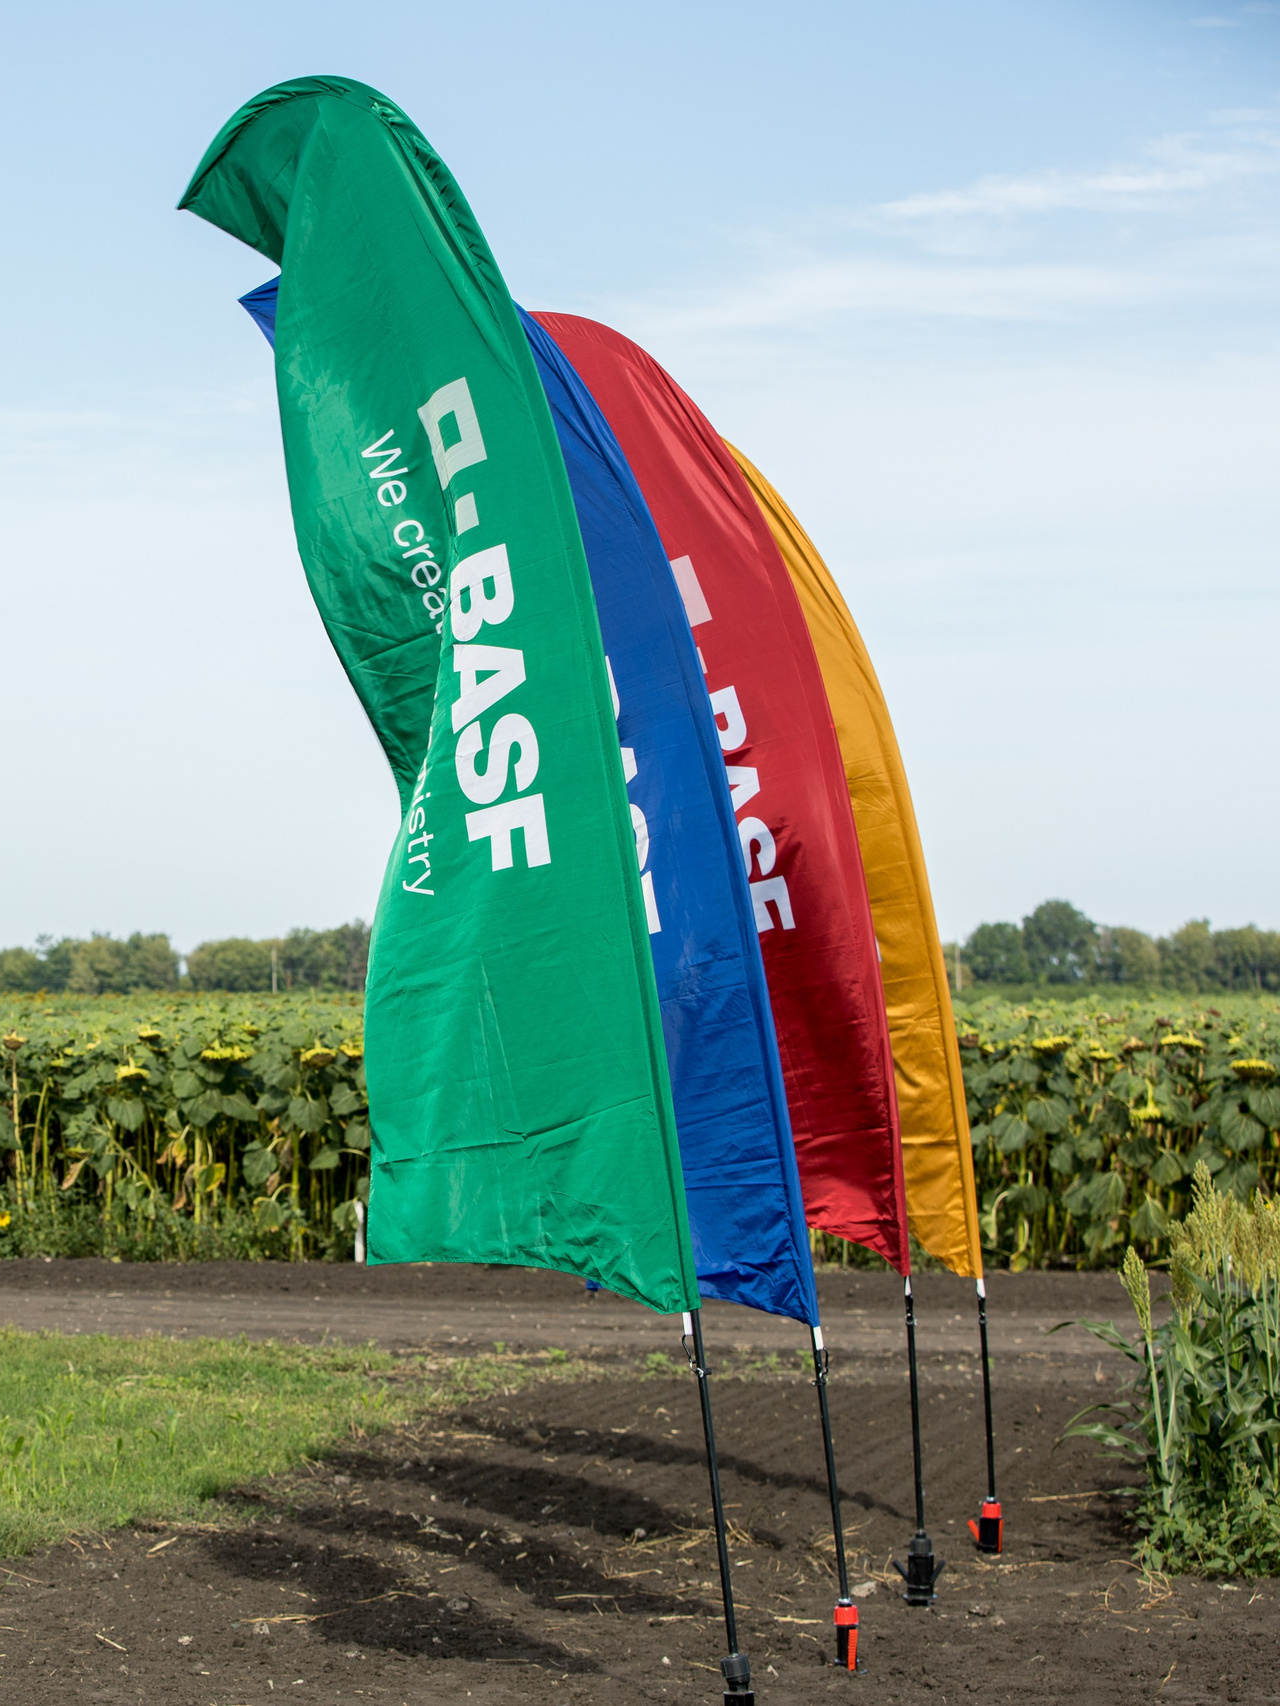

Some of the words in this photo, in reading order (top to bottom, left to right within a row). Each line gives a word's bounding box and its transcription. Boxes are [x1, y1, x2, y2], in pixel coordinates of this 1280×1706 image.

[361, 429, 408, 507] We
[393, 519, 448, 634] crea
[450, 543, 551, 872] BASF
